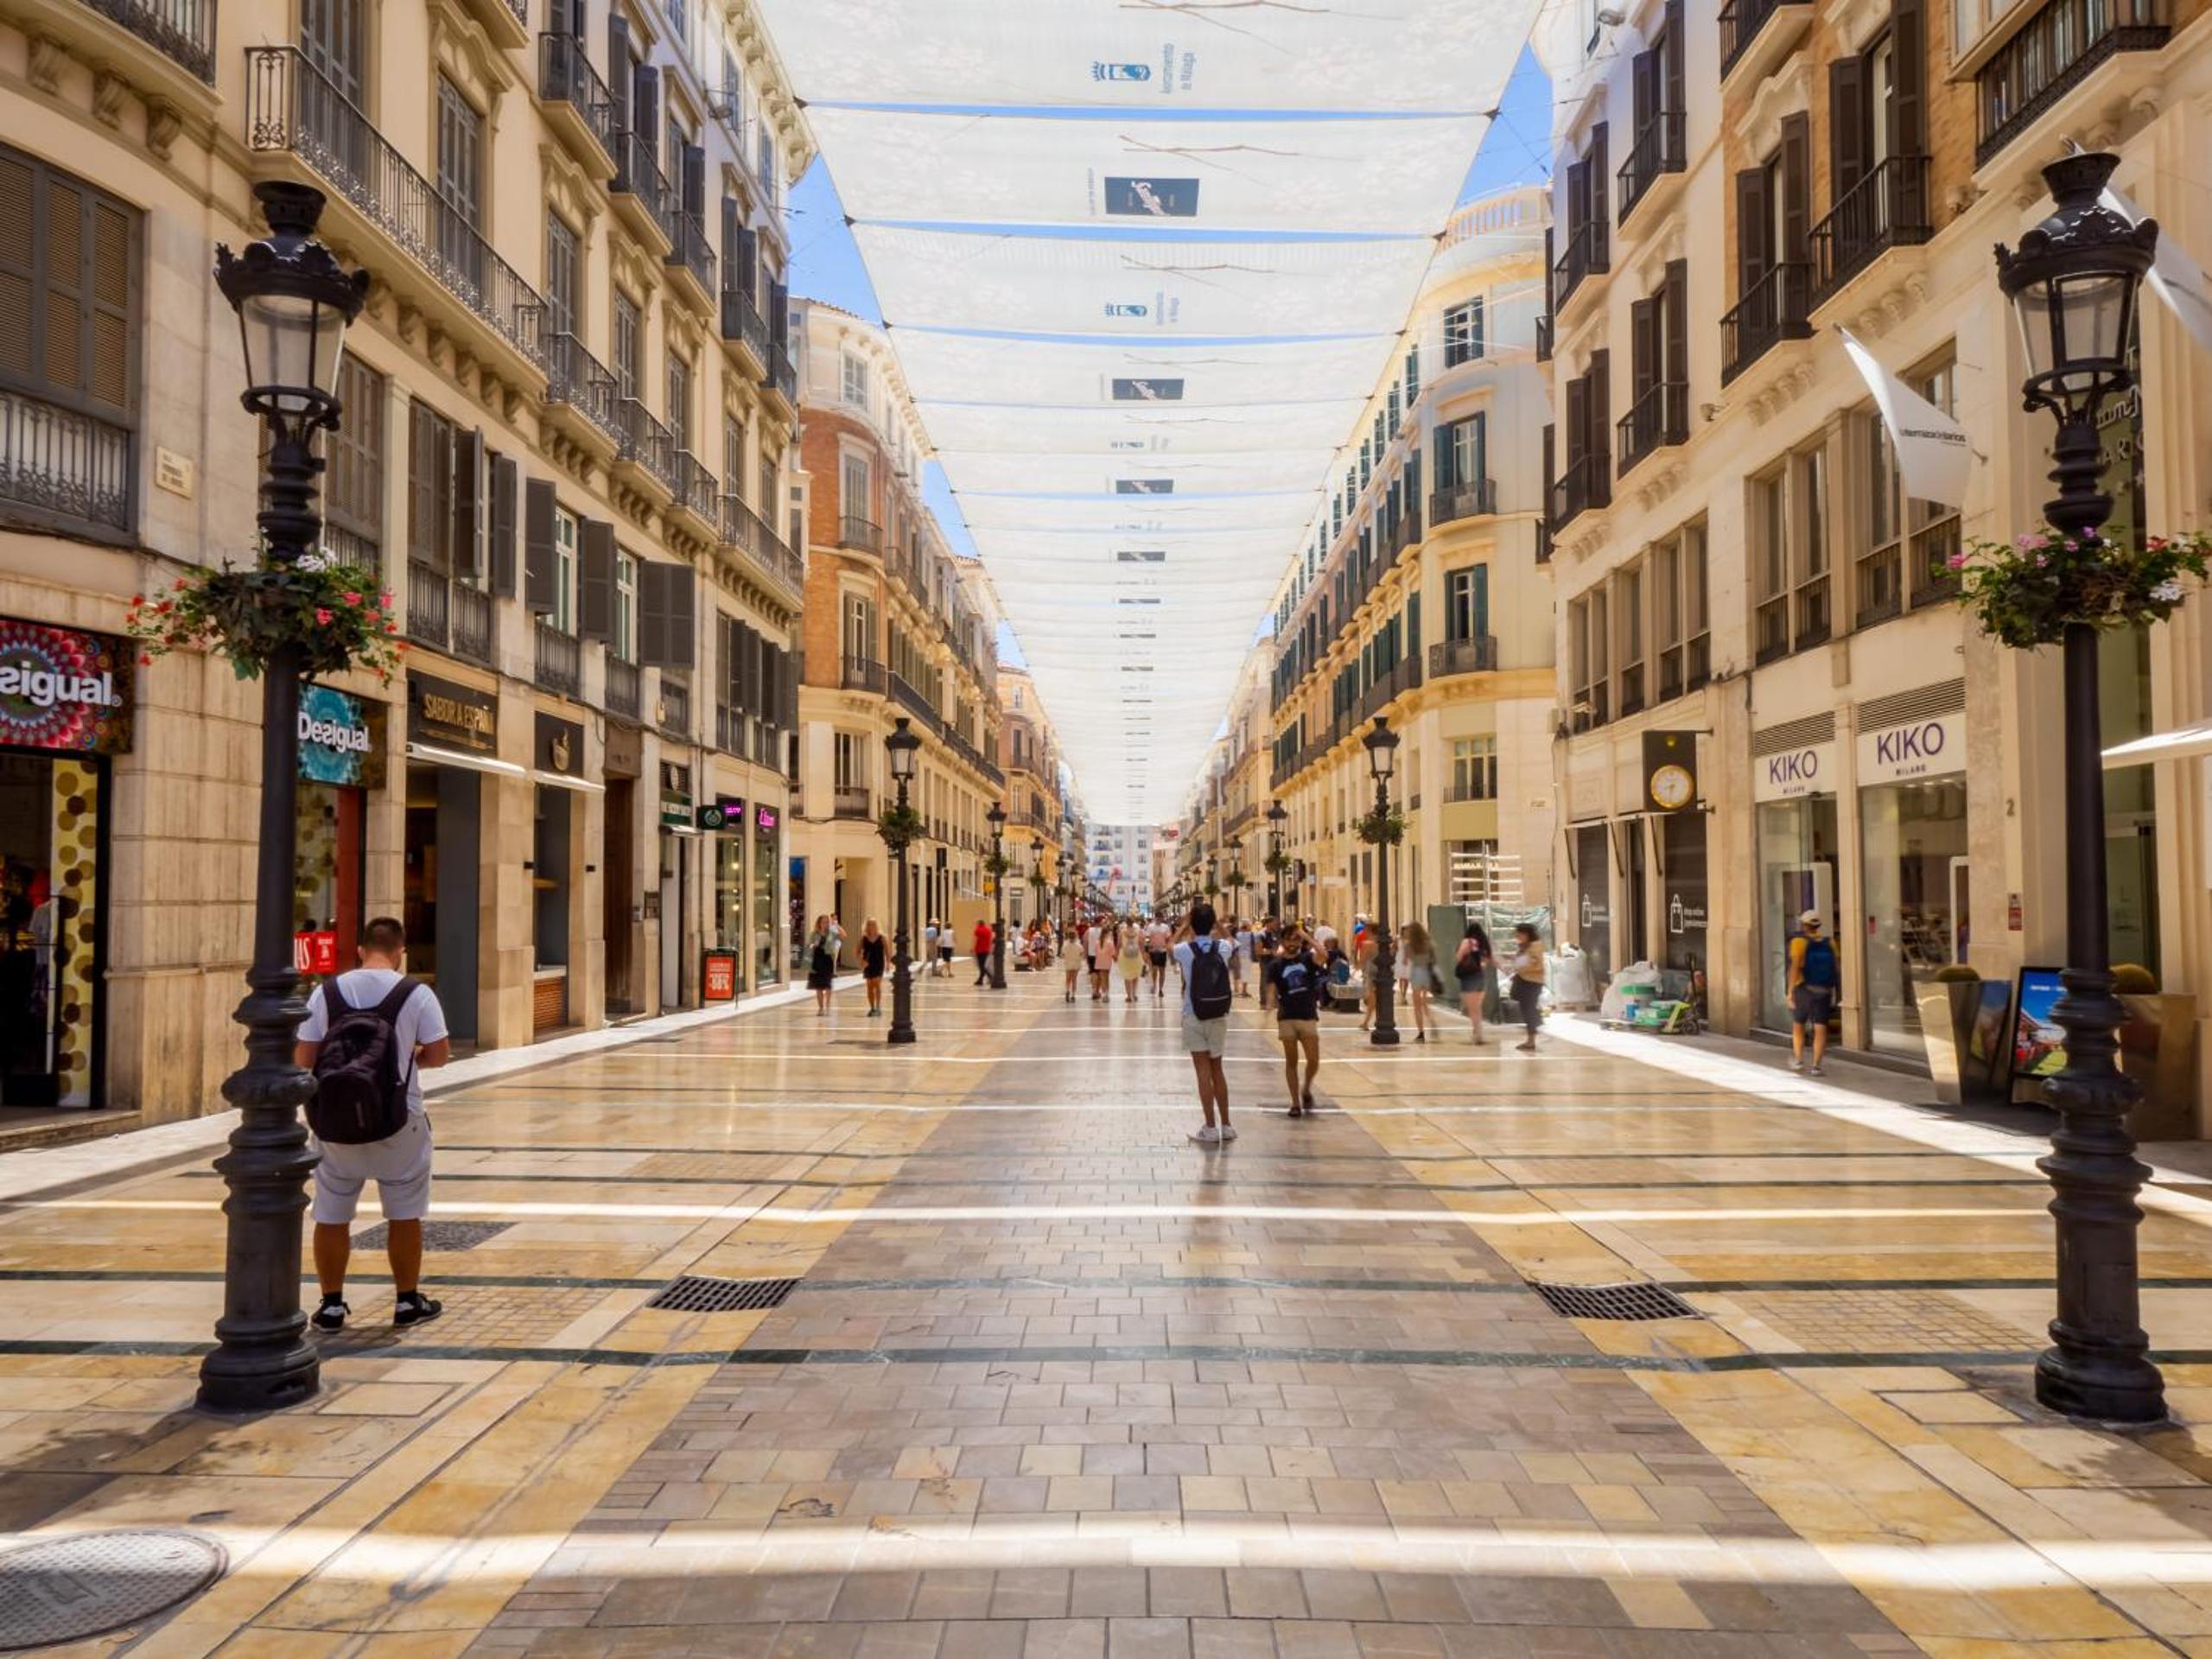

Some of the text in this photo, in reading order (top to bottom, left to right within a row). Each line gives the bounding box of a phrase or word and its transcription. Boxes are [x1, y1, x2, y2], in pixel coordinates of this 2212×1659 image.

[297, 711, 369, 753] Desigual
[1878, 722, 1944, 765] KIKO
[1770, 750, 1817, 784] KIKO
[2005, 798, 2015, 817] 2
